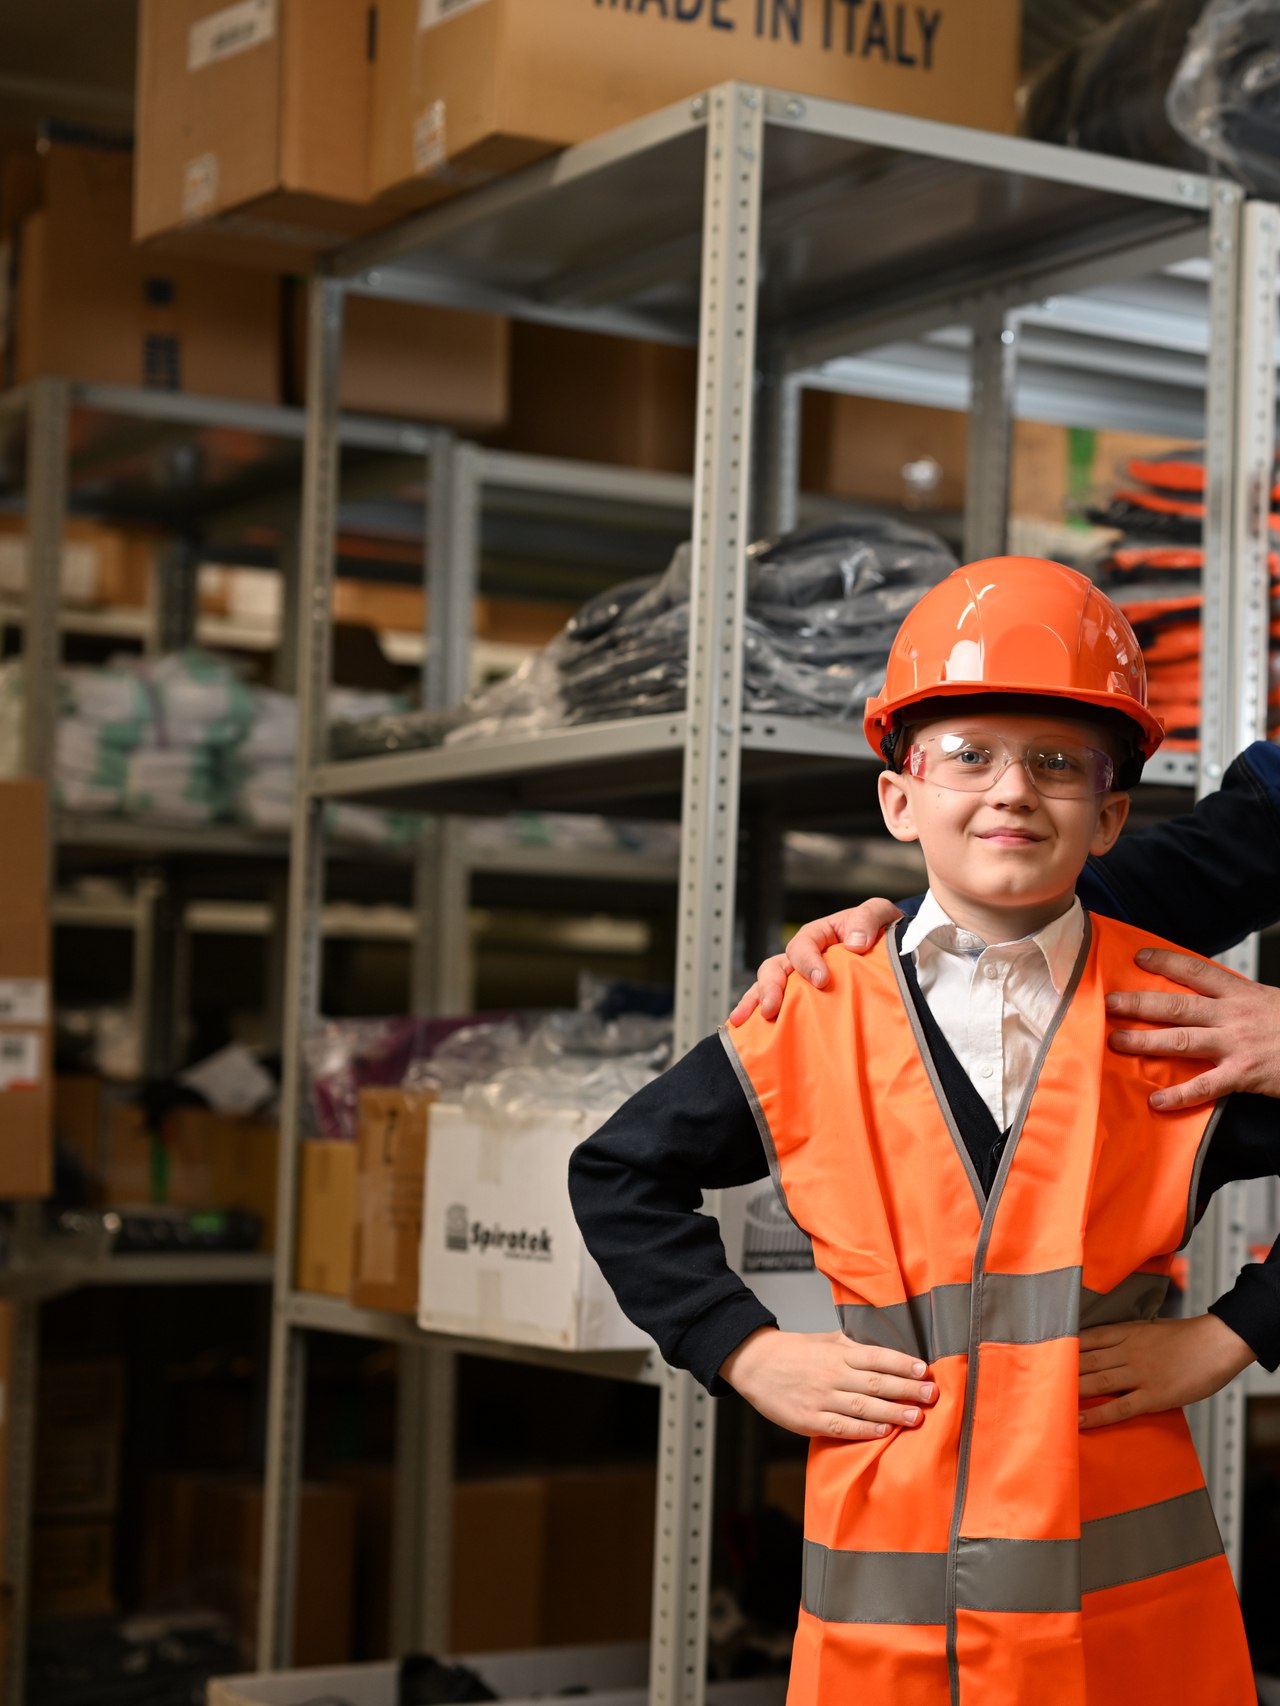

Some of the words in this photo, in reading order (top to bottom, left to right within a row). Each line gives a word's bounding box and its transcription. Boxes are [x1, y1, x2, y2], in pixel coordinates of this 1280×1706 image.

[594, 0, 735, 31] DE
[755, 0, 804, 44] IN
[822, 0, 943, 70] ITALY
